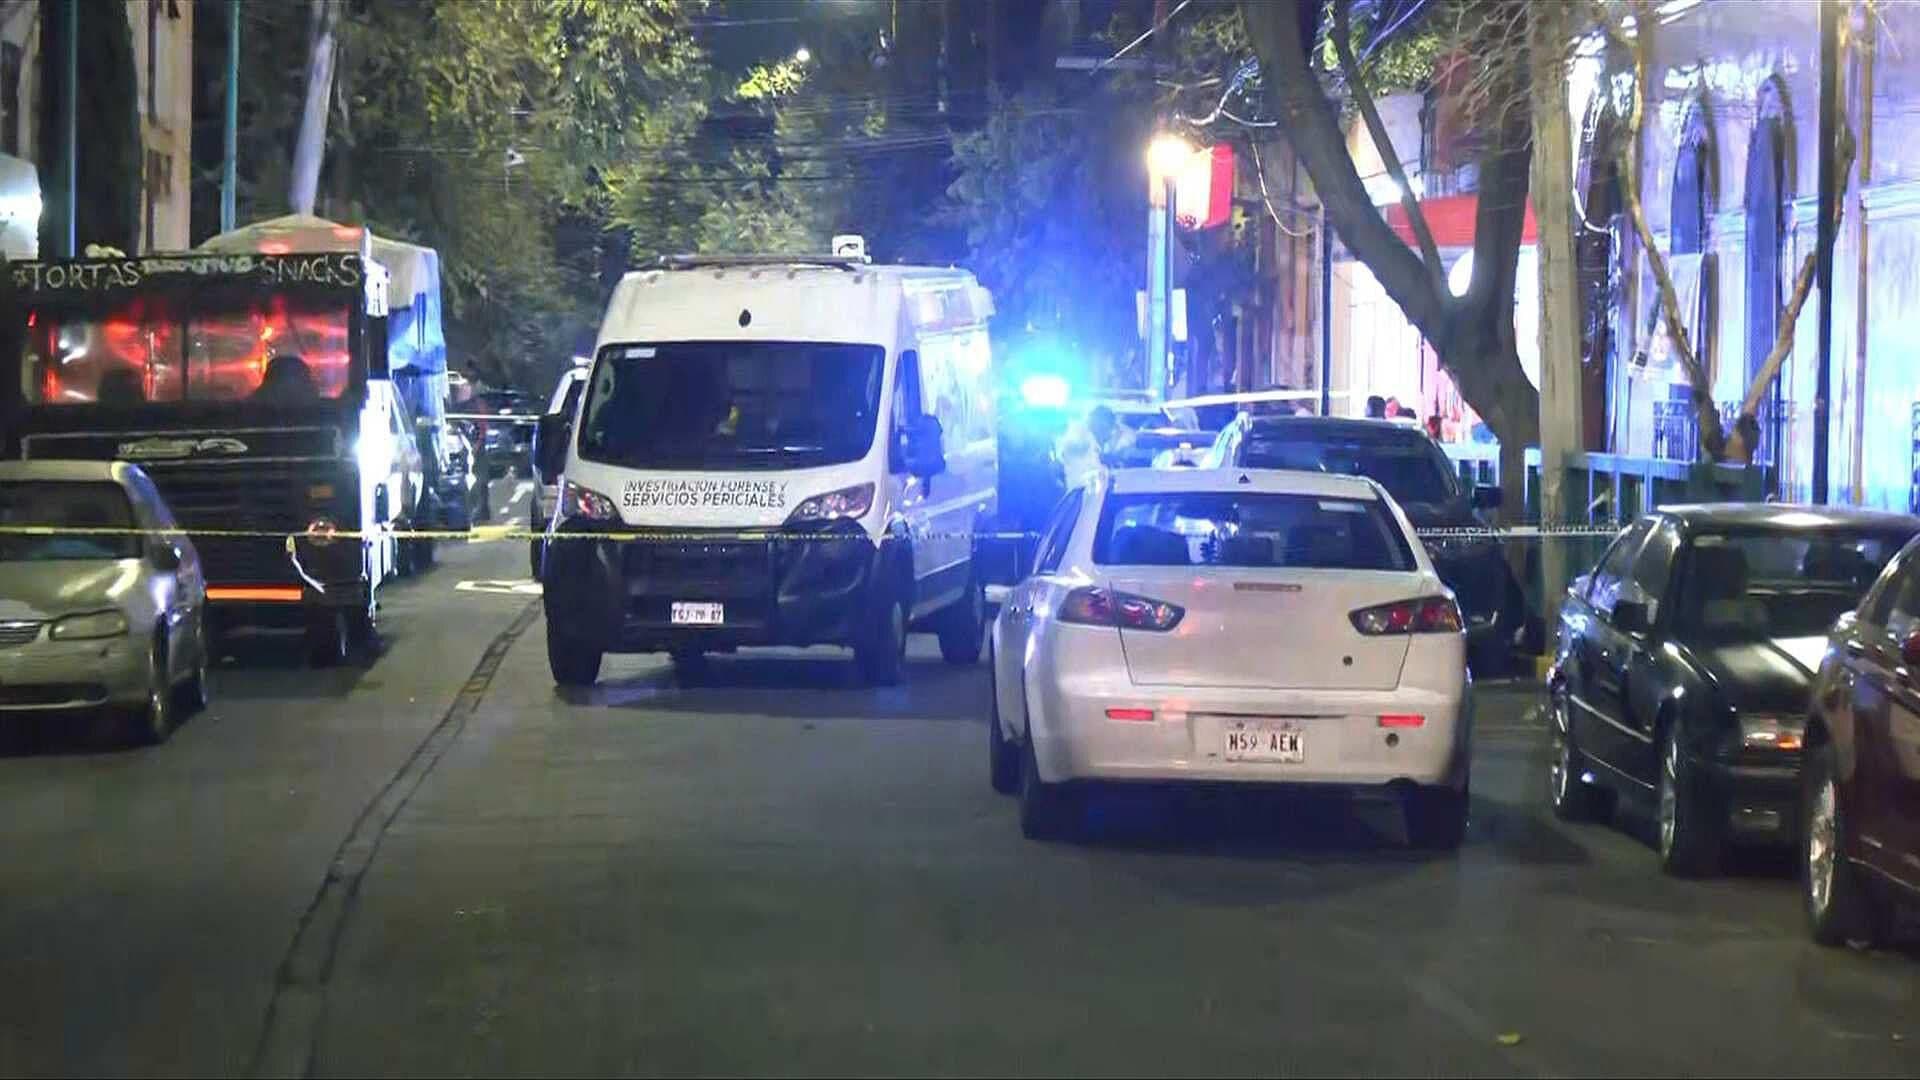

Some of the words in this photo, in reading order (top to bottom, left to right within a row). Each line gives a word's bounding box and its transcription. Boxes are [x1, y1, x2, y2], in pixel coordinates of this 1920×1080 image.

[22, 261, 140, 290] TORTAS
[719, 480, 776, 493] FORENSE
[623, 492, 698, 506] SERVICIOS
[702, 492, 785, 507] PERICIALES
